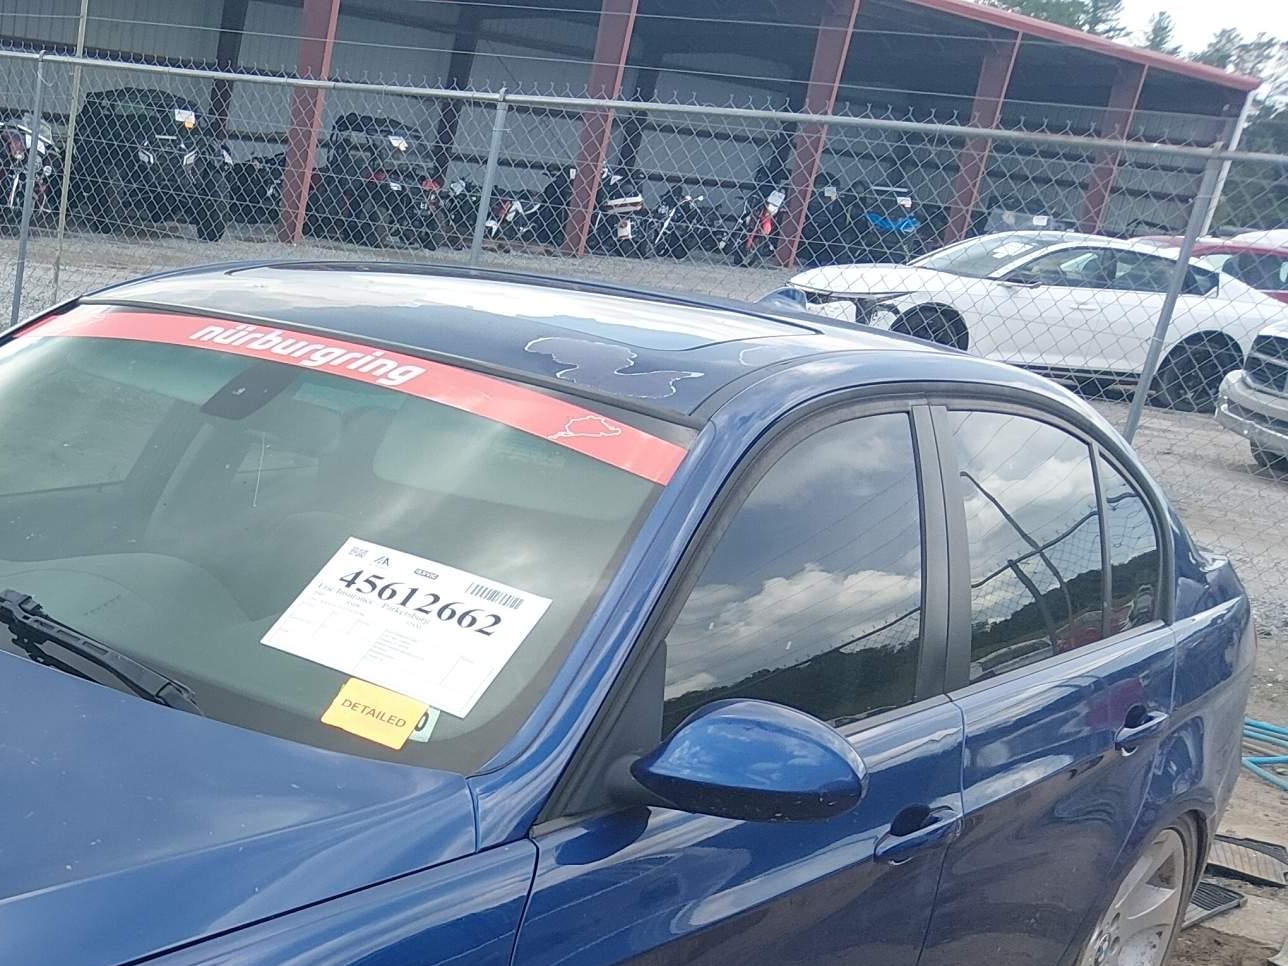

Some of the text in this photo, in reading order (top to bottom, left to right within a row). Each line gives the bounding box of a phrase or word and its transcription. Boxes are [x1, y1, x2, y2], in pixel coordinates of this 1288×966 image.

[189, 323, 426, 386] nürburgring
[338, 569, 502, 637] 45612662
[340, 698, 408, 729] DETAILED
